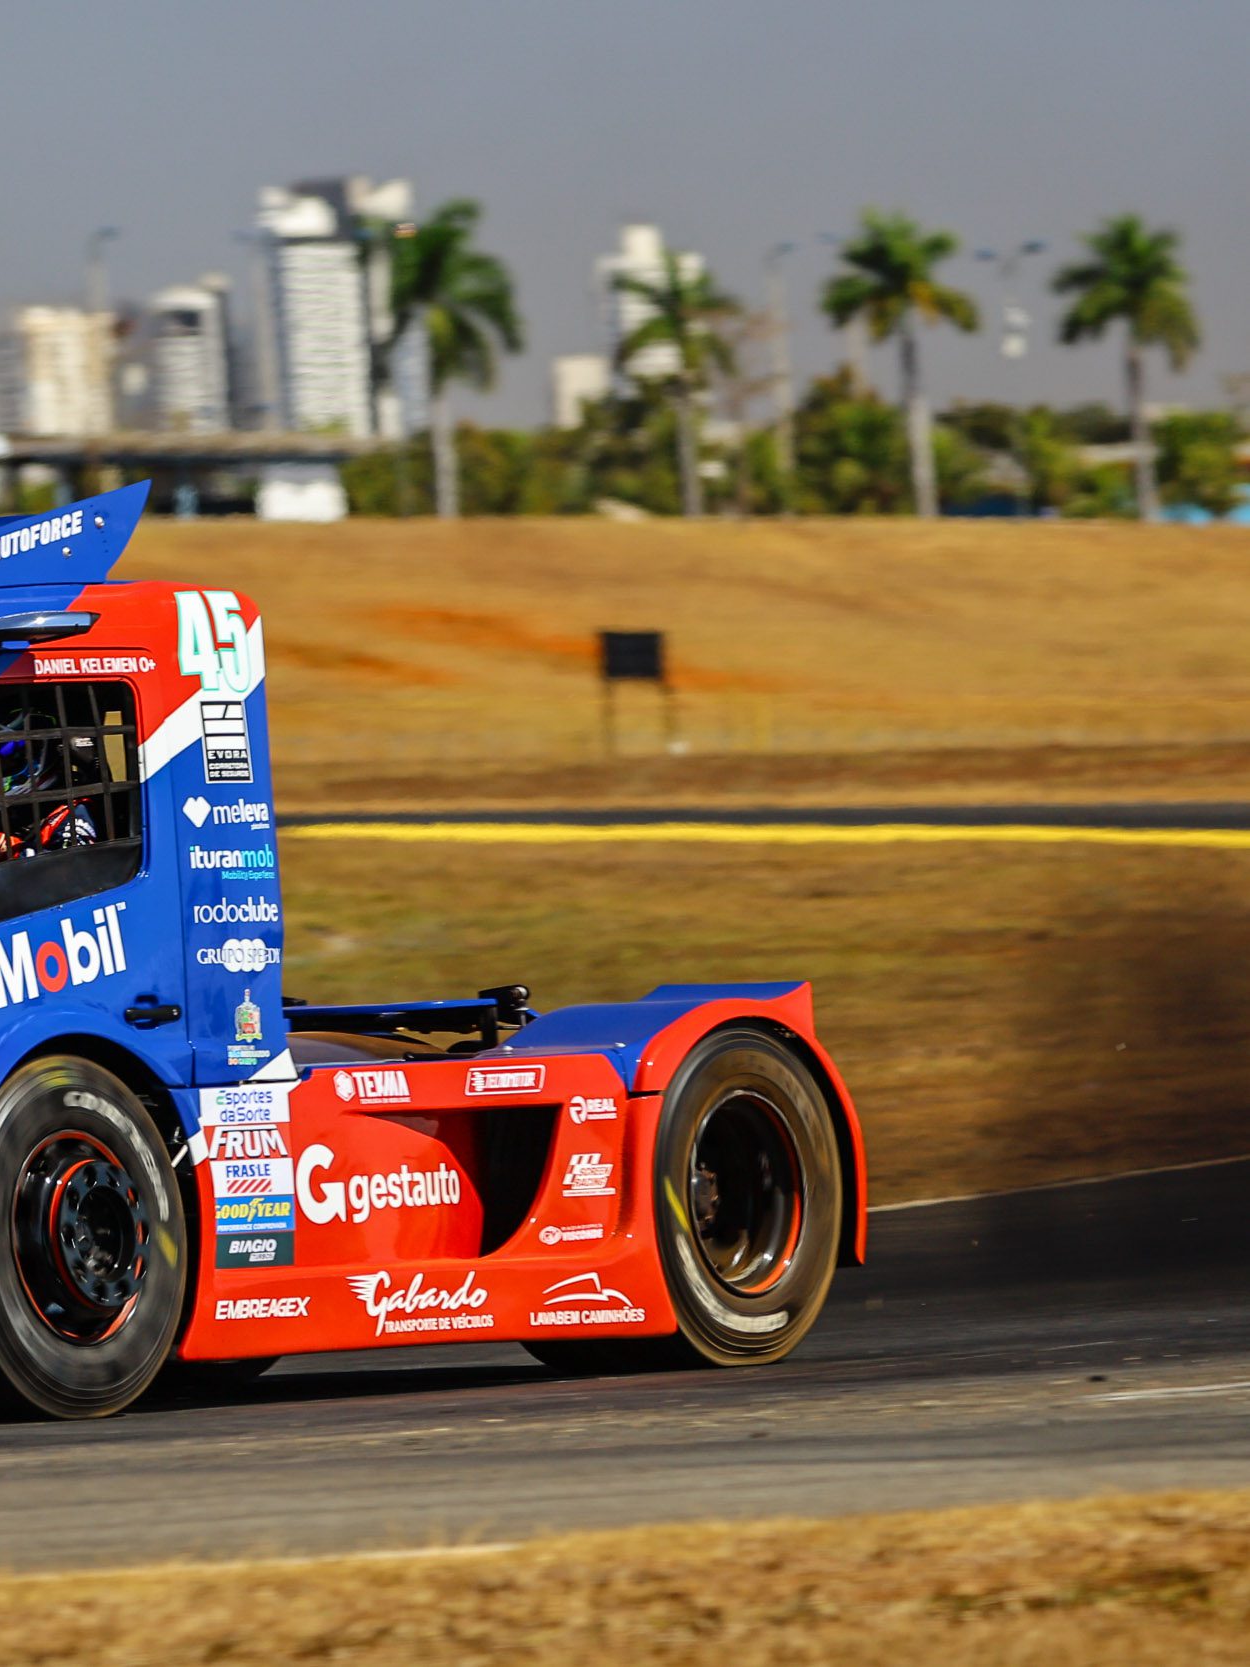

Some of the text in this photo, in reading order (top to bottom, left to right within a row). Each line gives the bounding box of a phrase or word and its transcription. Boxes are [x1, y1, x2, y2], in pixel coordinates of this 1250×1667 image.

[174, 591, 252, 693] 45
[35, 657, 79, 675] DANIEL
[81, 656, 138, 674] KELEMEN
[213, 799, 270, 825] meleva
[190, 844, 275, 869] ituranmob
[194, 896, 279, 923] rodoclube
[209, 1124, 289, 1161] FRUM
[349, 1163, 461, 1224] gestauto
[229, 1238, 278, 1254] BIAGIO
[215, 1296, 311, 1320] EMBREAGEX
[346, 1270, 490, 1337] Gabardo
[530, 1306, 646, 1326] LAVABEM CAMINHÕES
[385, 1312, 494, 1334] TRANSPORTE DE VEÍCULOS
